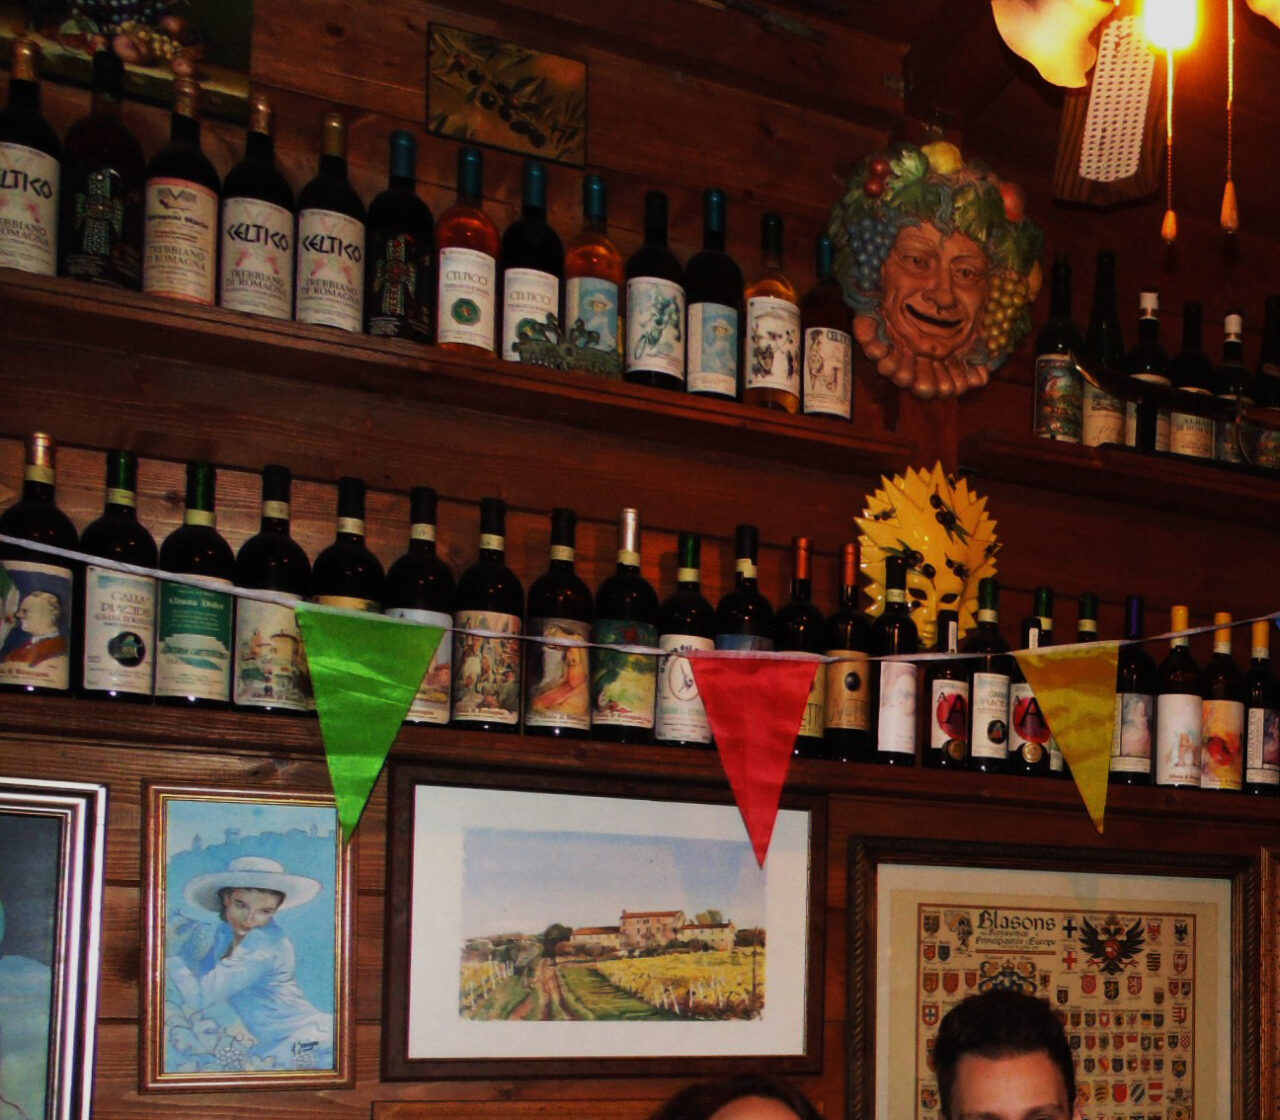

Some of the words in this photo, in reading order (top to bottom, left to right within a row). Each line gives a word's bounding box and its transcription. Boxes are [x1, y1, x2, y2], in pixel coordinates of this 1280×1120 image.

[227, 222, 289, 253] CELTICO
[302, 234, 362, 263] CELTICO
[976, 909, 1057, 931] Blasons
